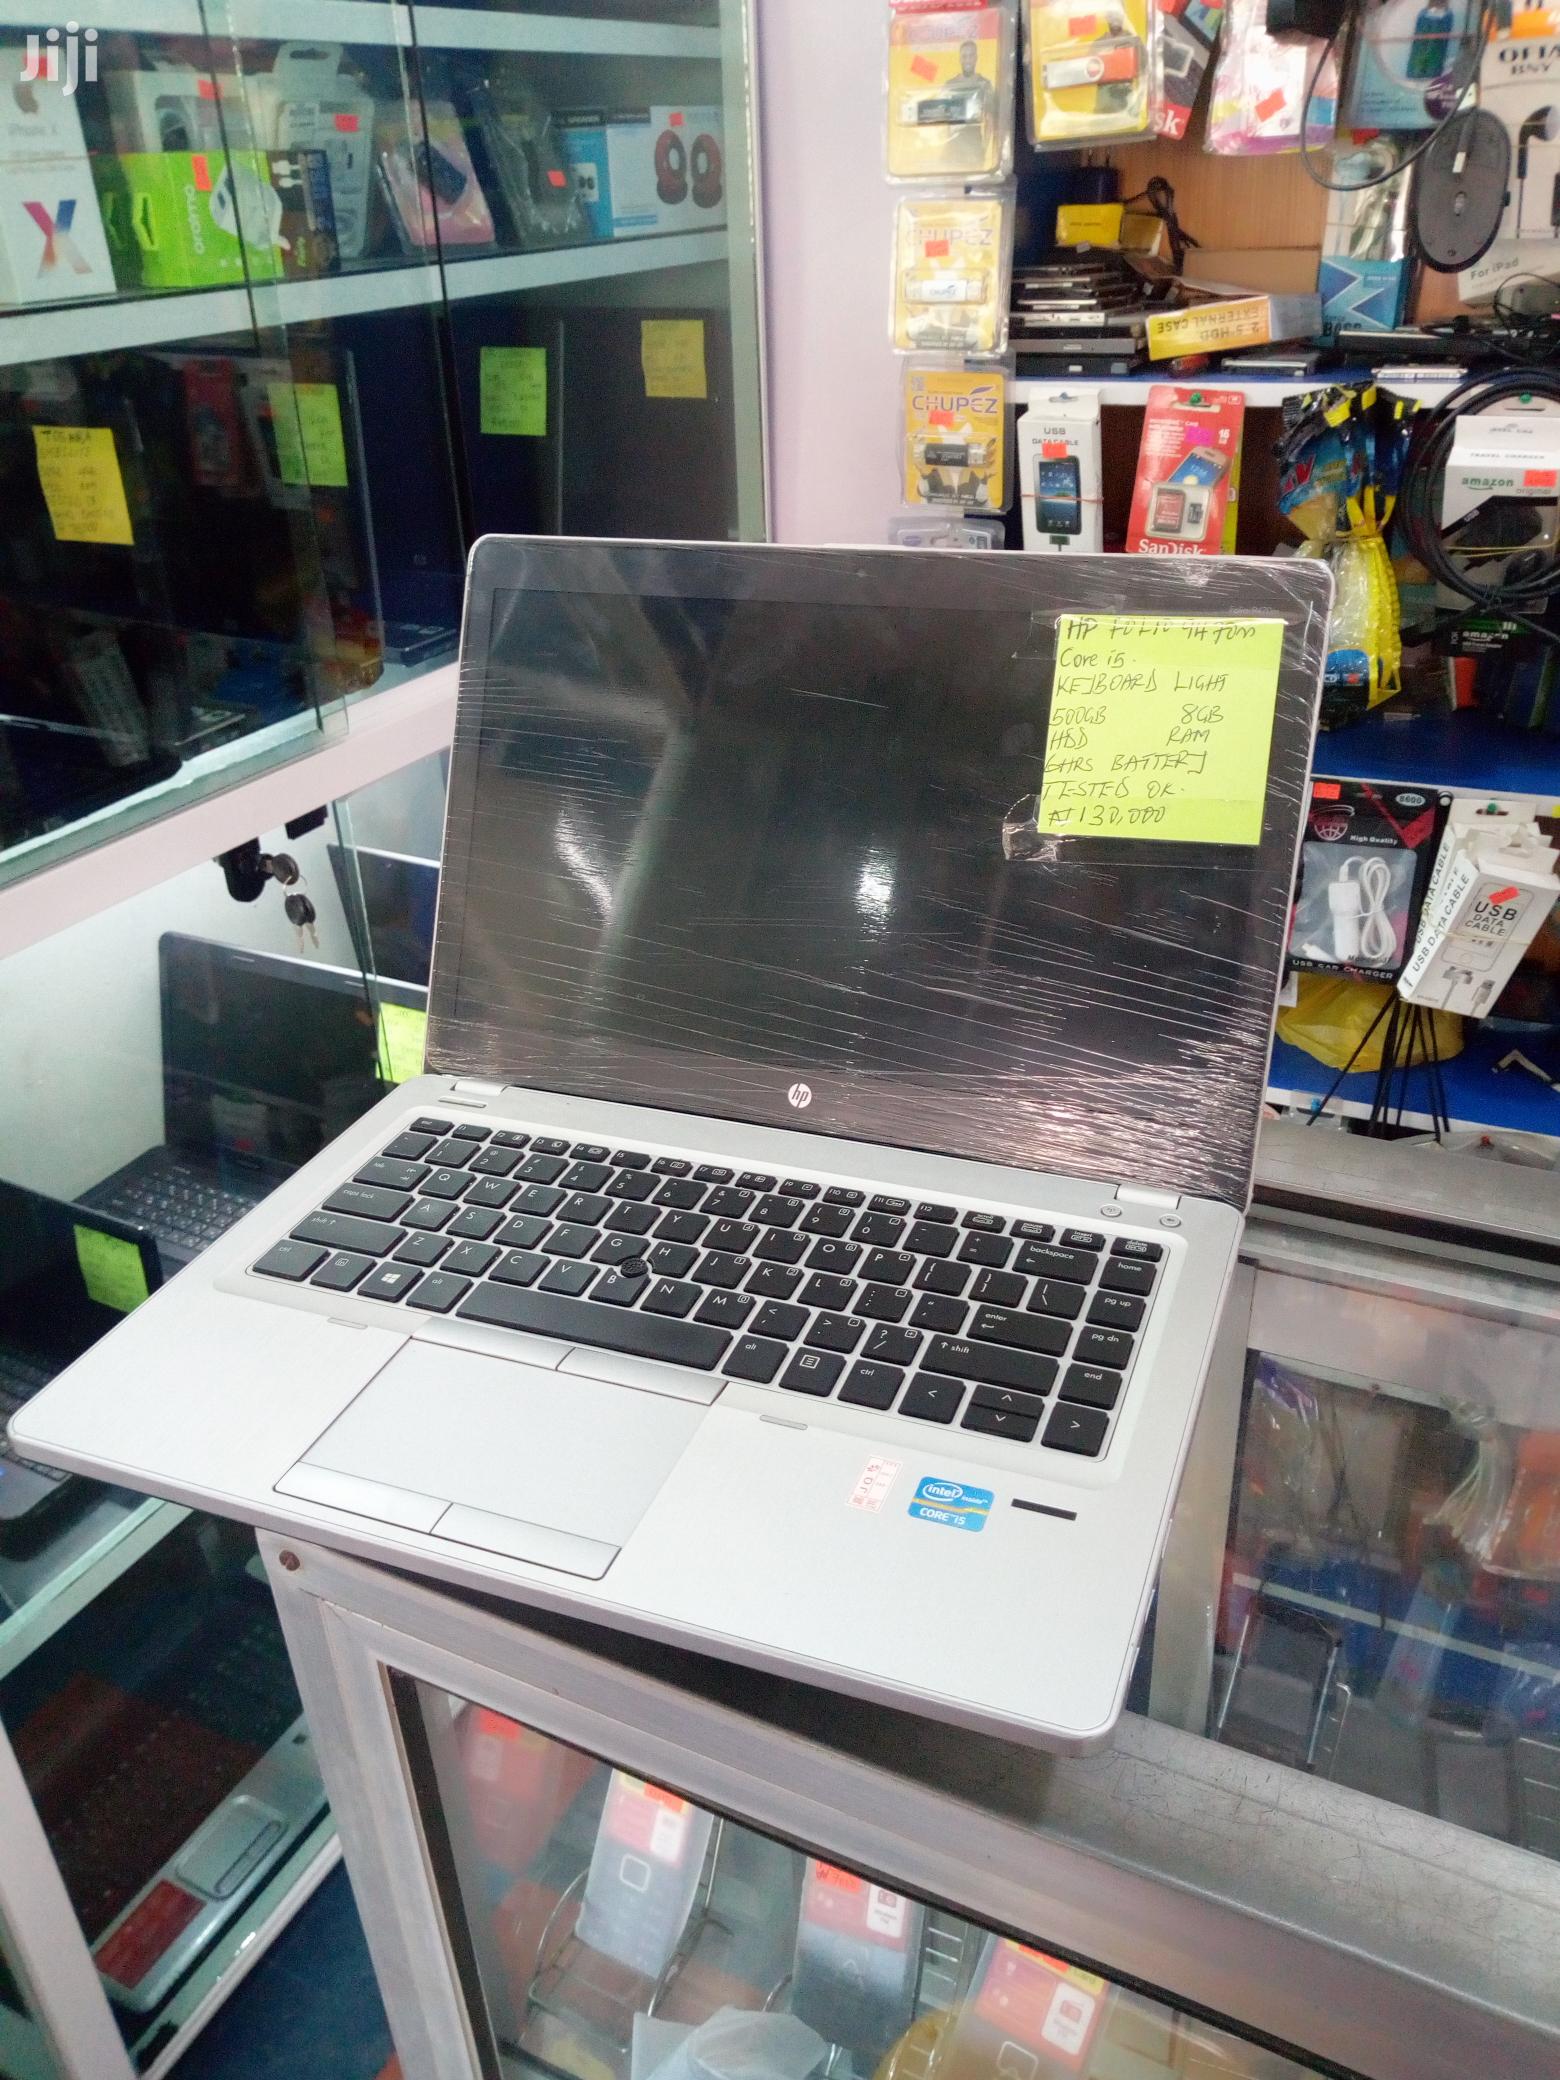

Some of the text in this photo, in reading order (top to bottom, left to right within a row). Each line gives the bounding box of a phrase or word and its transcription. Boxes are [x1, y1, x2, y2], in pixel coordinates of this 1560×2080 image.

[1156, 317, 1189, 334] CASE
[911, 395, 999, 414] CHUPEZ
[1043, 427, 1067, 435] USB
[1461, 477, 1514, 489] amazon
[1060, 646, 1098, 668] Core
[1173, 671, 1229, 692] LIGHT
[1049, 703, 1224, 726] 500GB 8GB
[1050, 726, 1210, 750] HDD RAM
[1042, 776, 1130, 801] TESTED
[1350, 834, 1398, 846] High Quality
[1474, 901, 1518, 921] USB
[1412, 946, 1430, 973] USB
[1427, 916, 1448, 947] DATA
[1443, 873, 1470, 916] CABLE
[1472, 913, 1505, 928] DATA
[1464, 920, 1506, 937] CABLE
[1292, 959, 1394, 979] USB CAR CHARGER
[438, 1173, 451, 1182] Q
[485, 1181, 501, 1190] W
[527, 1189, 538, 1198] E
[574, 1197, 584, 1206] R
[420, 1203, 431, 1212] A
[465, 1211, 477, 1220] S
[512, 1219, 524, 1229] D
[720, 1223, 732, 1232] U
[560, 1228, 571, 1237] F
[412, 1236, 425, 1246] Z
[610, 1238, 623, 1248] G
[460, 1246, 473, 1255] X
[658, 1247, 672, 1257] H
[822, 1243, 836, 1253] O
[1030, 1245, 1075, 1260] backspace
[510, 1255, 523, 1265] C
[709, 1257, 719, 1266] J
[874, 1253, 884, 1262] P
[561, 1264, 573, 1274] V
[1117, 1261, 1143, 1272] home
[762, 1267, 774, 1277] K
[607, 1274, 618, 1284] B
[660, 1283, 675, 1295] N
[712, 1295, 728, 1306] M
[1104, 1296, 1132, 1308] pg up
[985, 1312, 1008, 1322] enter
[1091, 1332, 1120, 1343] pg dn
[950, 1344, 970, 1354] shift
[860, 1367, 875, 1377] ctrl
[1084, 1370, 1103, 1381] end
[926, 1482, 959, 1499] intel
[919, 1506, 950, 1523] CORE
